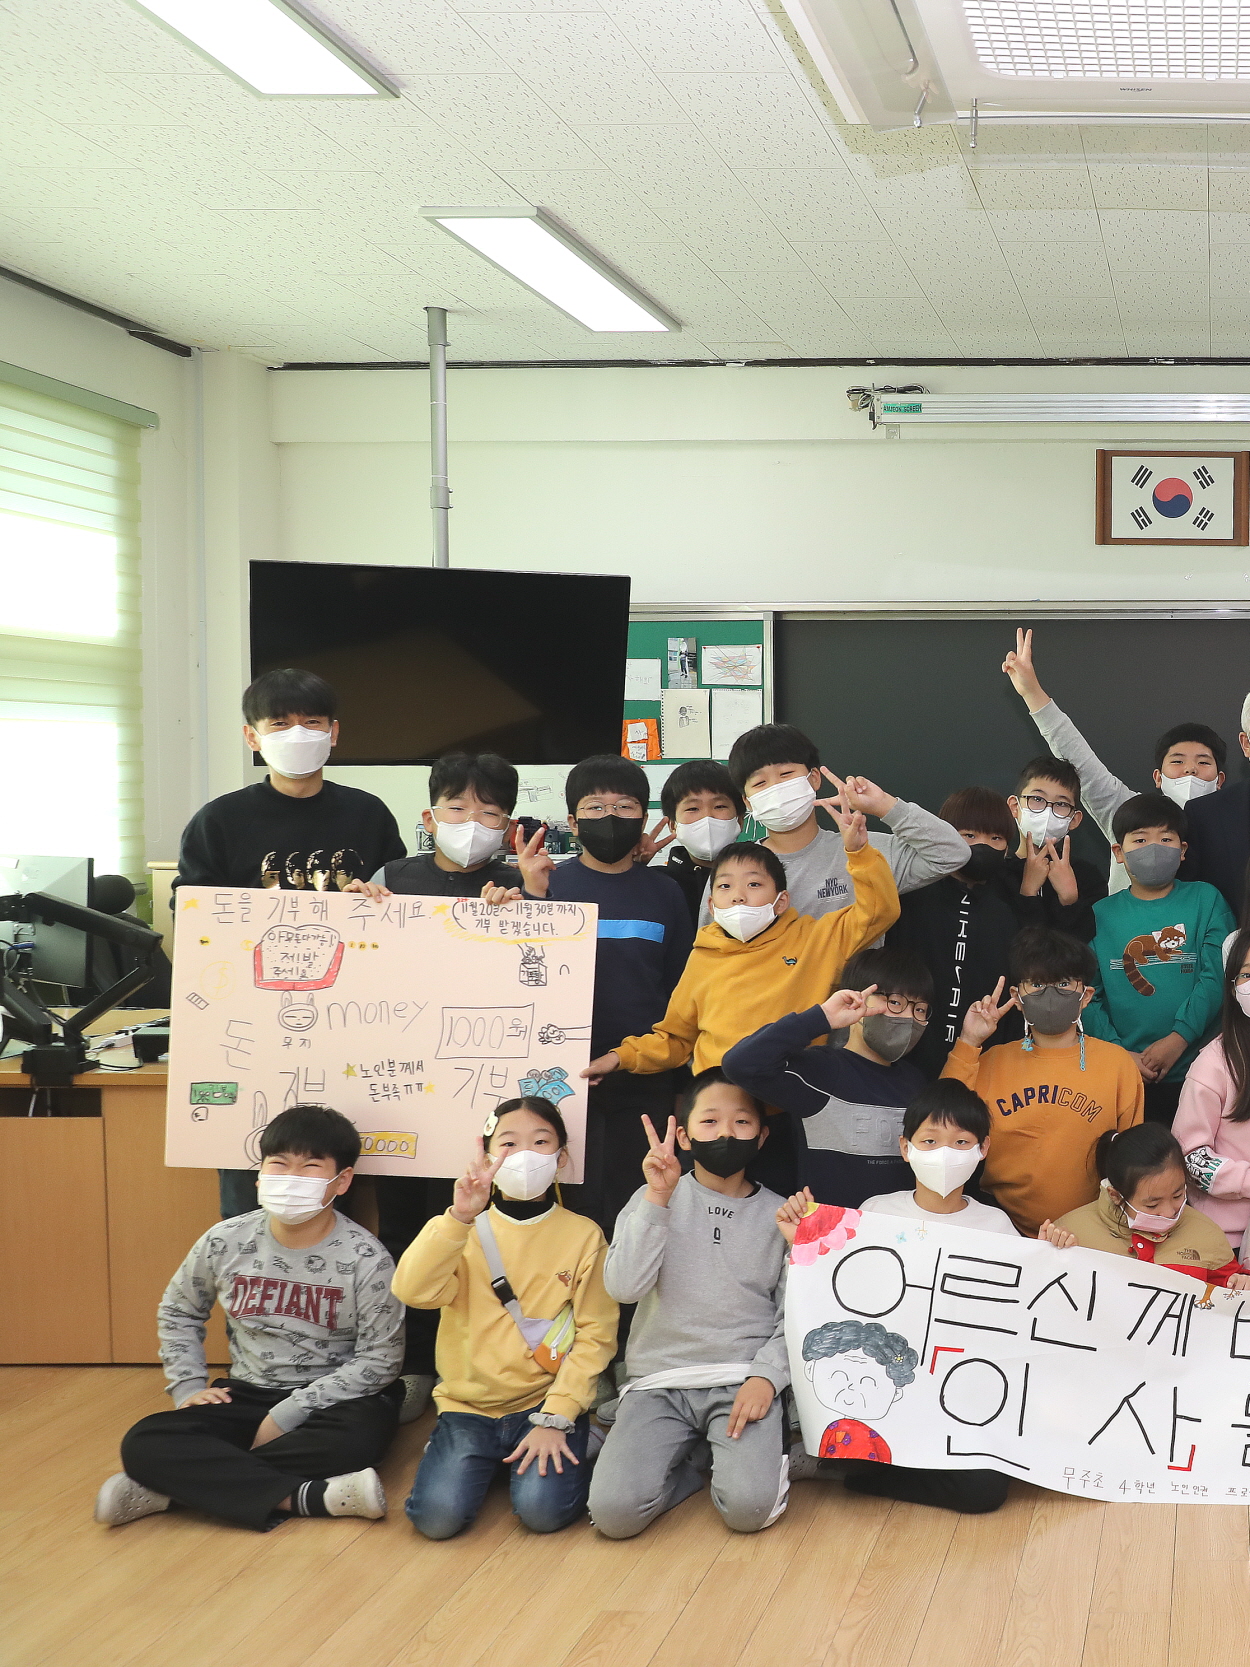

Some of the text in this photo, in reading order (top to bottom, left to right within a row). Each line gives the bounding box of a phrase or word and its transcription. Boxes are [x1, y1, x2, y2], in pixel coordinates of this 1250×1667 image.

[825, 878, 838, 887] NYC
[211, 892, 252, 924] 돈을
[327, 1000, 430, 1033] money
[945, 987, 960, 1043] AIR
[220, 1019, 256, 1070] 돈
[453, 1063, 509, 1109] 기부
[708, 1206, 735, 1219] LOVE
[230, 1275, 344, 1330] DEFIANT
[1063, 1467, 1104, 1489] 무주초
[1118, 1479, 1156, 1495] 4학년
